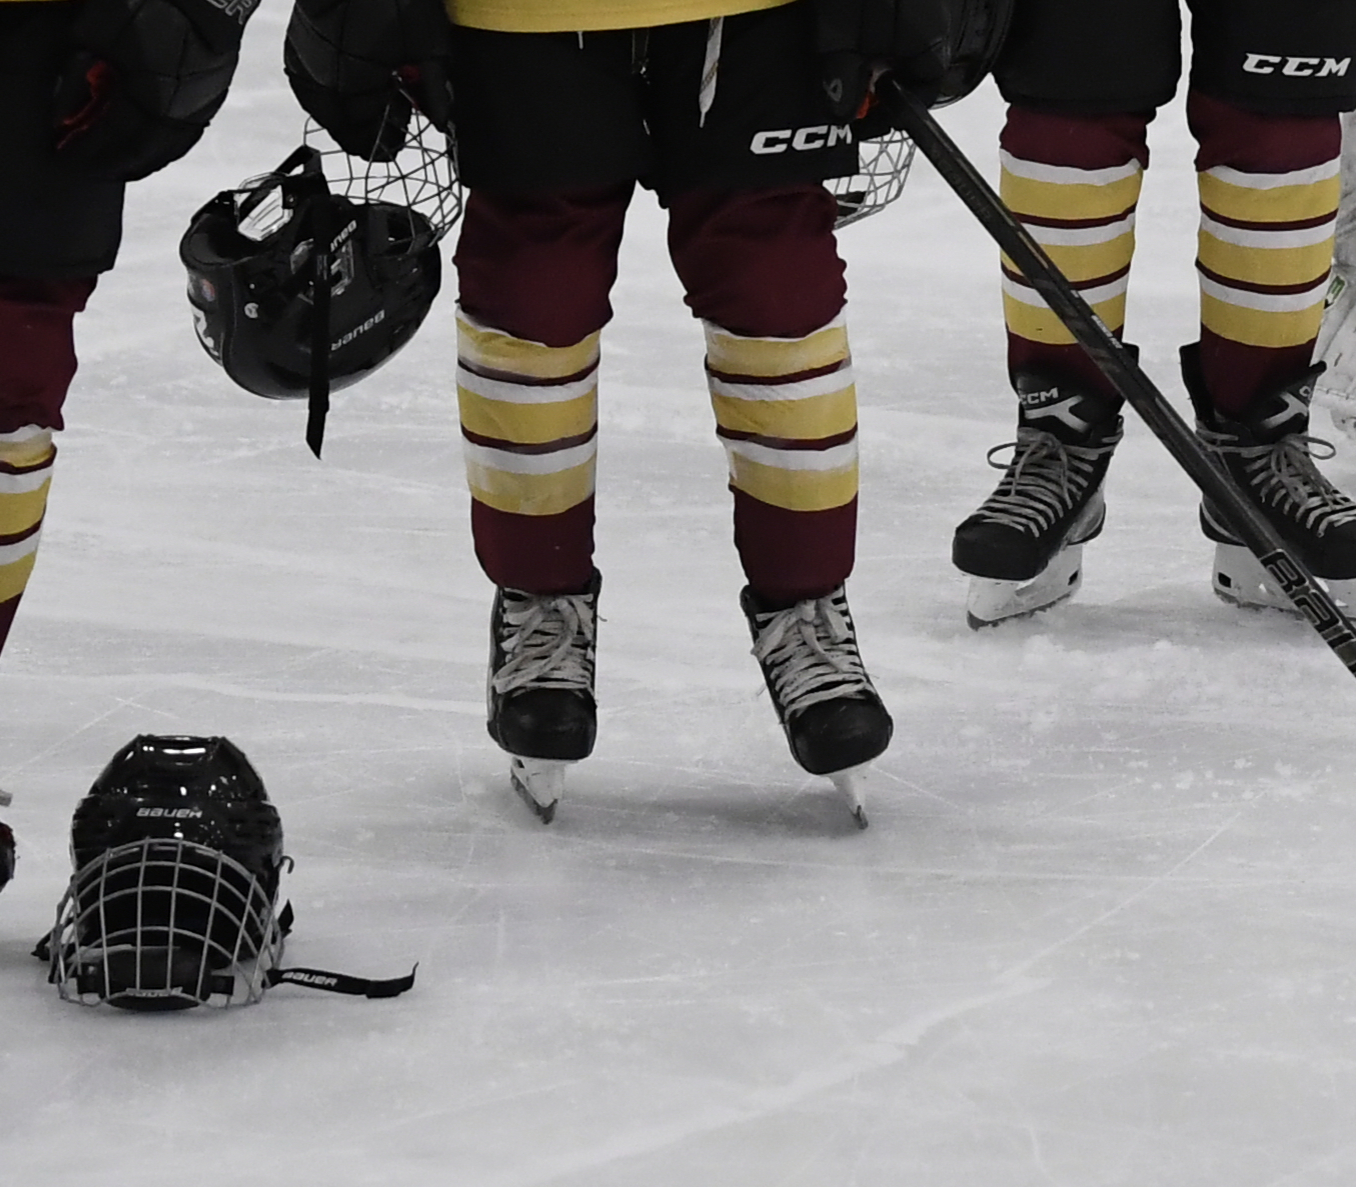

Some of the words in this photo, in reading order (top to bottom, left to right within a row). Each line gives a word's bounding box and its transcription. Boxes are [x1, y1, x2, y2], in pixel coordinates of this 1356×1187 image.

[1242, 53, 1352, 77] CCM
[750, 124, 853, 155] CCM
[331, 309, 386, 352] BAUER
